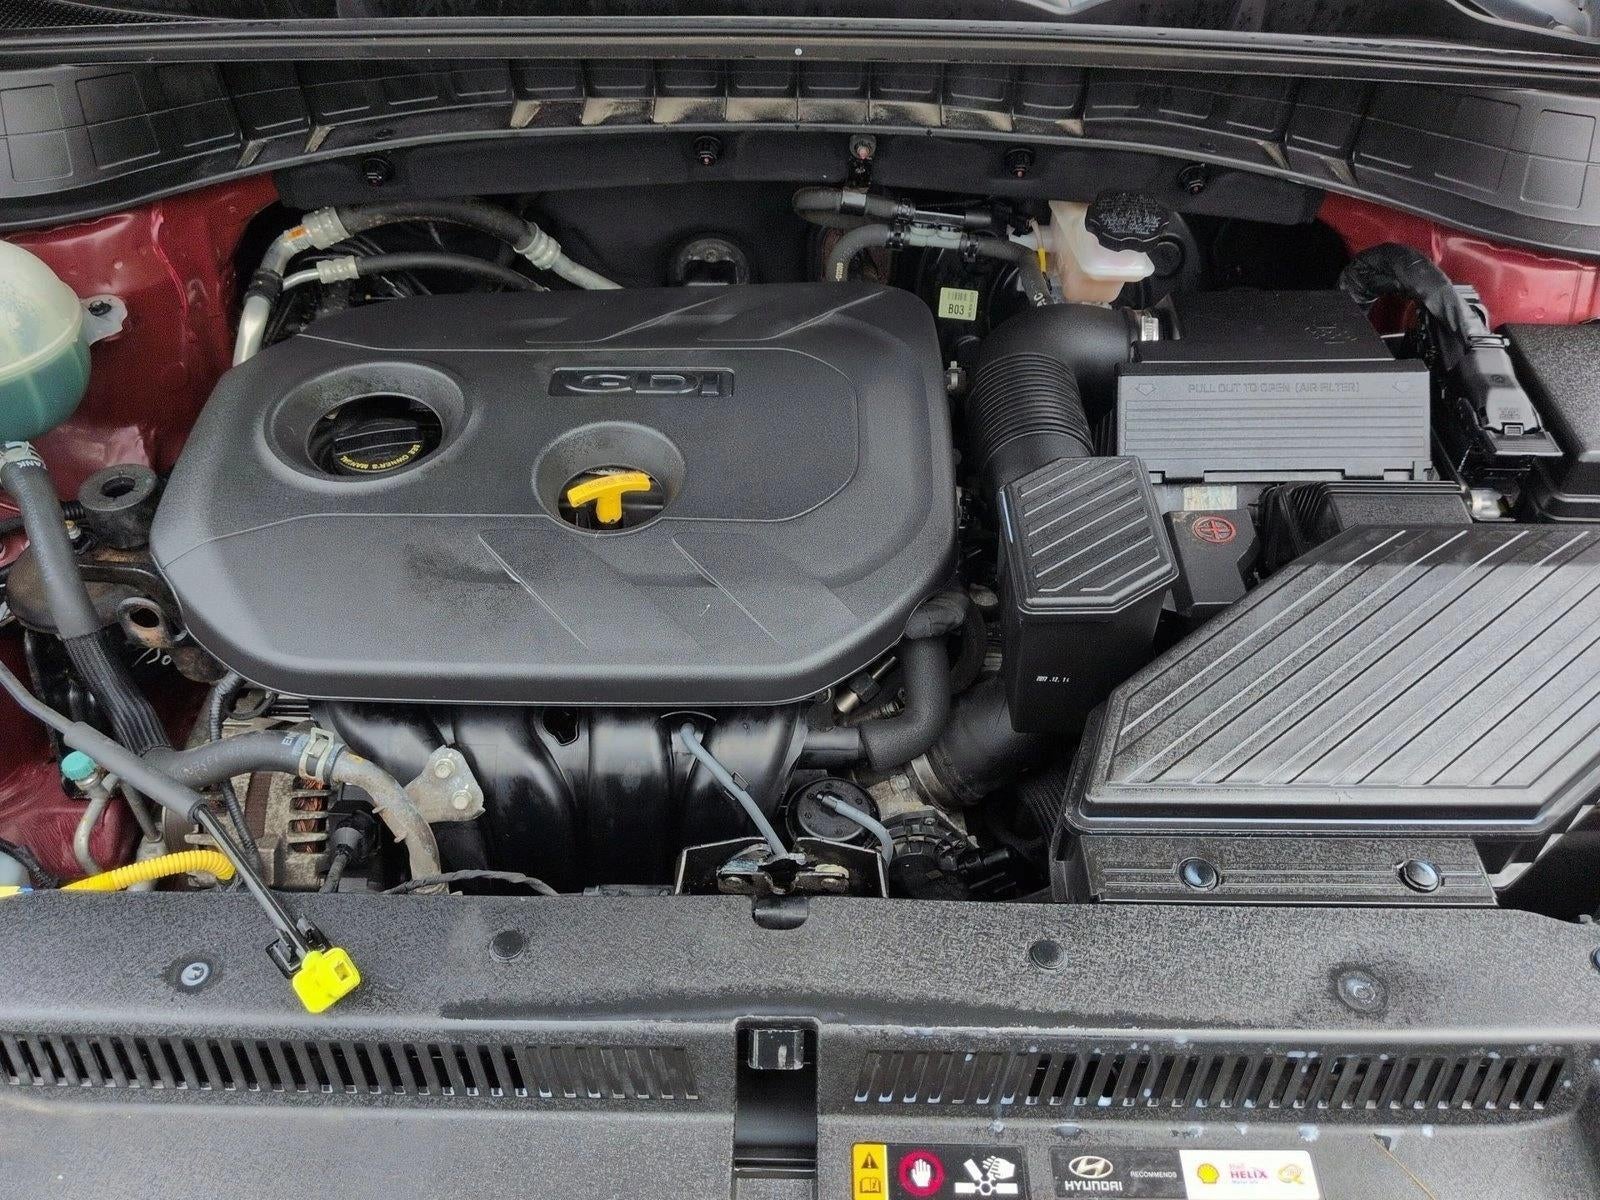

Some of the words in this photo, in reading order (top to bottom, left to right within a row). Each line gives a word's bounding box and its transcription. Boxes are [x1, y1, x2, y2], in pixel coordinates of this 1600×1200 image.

[948, 303, 965, 315] B03
[1188, 383, 1216, 393] PULL
[1218, 383, 1241, 393] OUT
[1244, 383, 1258, 393] TO
[1260, 382, 1290, 393] OPEN
[1130, 1171, 1178, 1179] RECOMMENDS
[1230, 1169, 1268, 1179] HELIX
[1064, 1180, 1123, 1191] HYUNDAI
